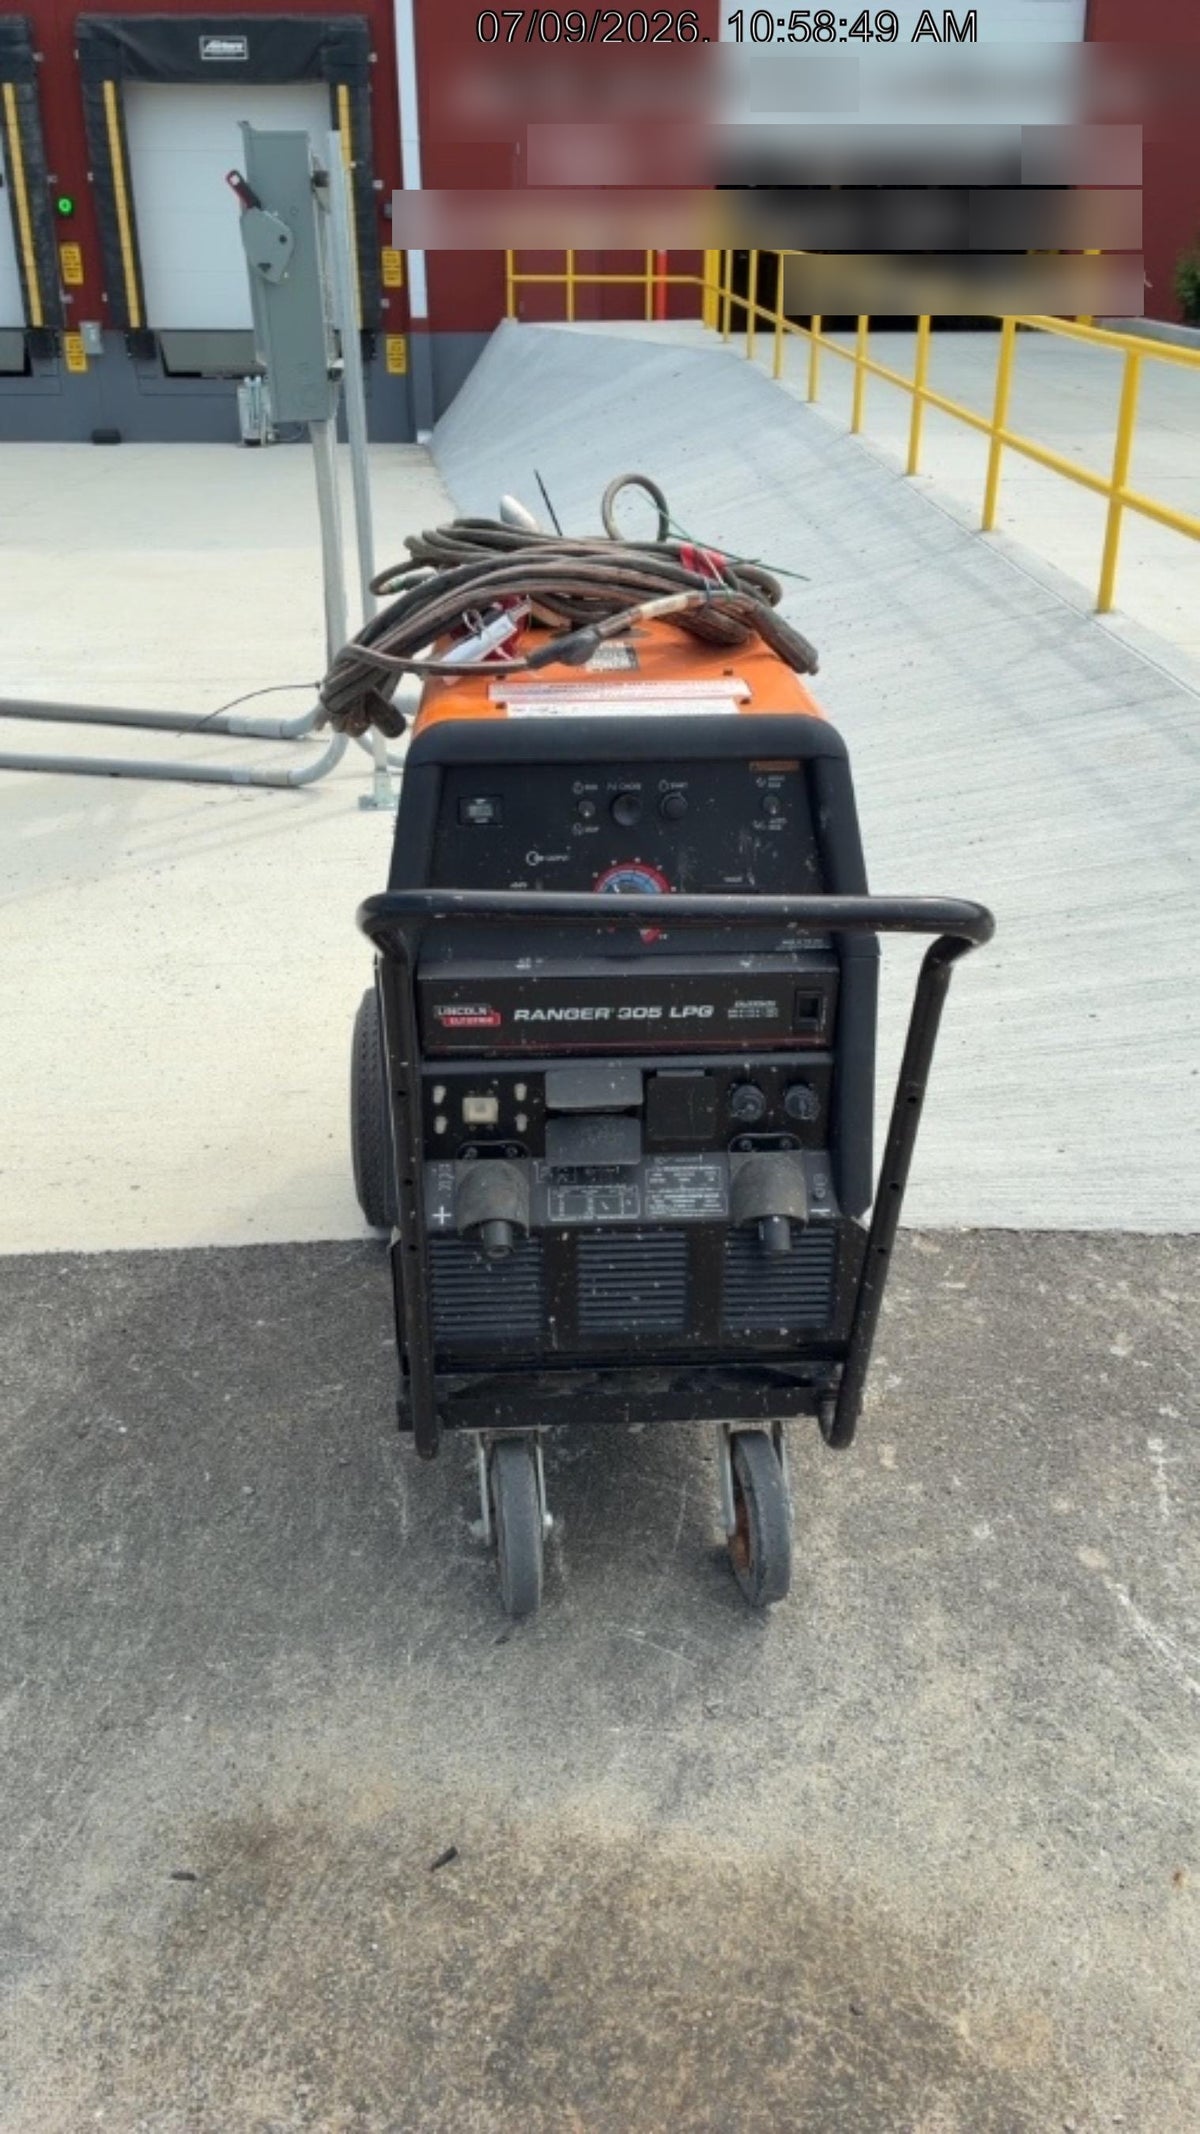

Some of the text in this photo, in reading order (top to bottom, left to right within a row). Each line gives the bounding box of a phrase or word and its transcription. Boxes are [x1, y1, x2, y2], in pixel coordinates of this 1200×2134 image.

[437, 1006, 488, 1016] LINCOLN
[514, 1007, 611, 1021] RANGER
[617, 1006, 663, 1020] 305
[669, 1005, 714, 1018] LPG
